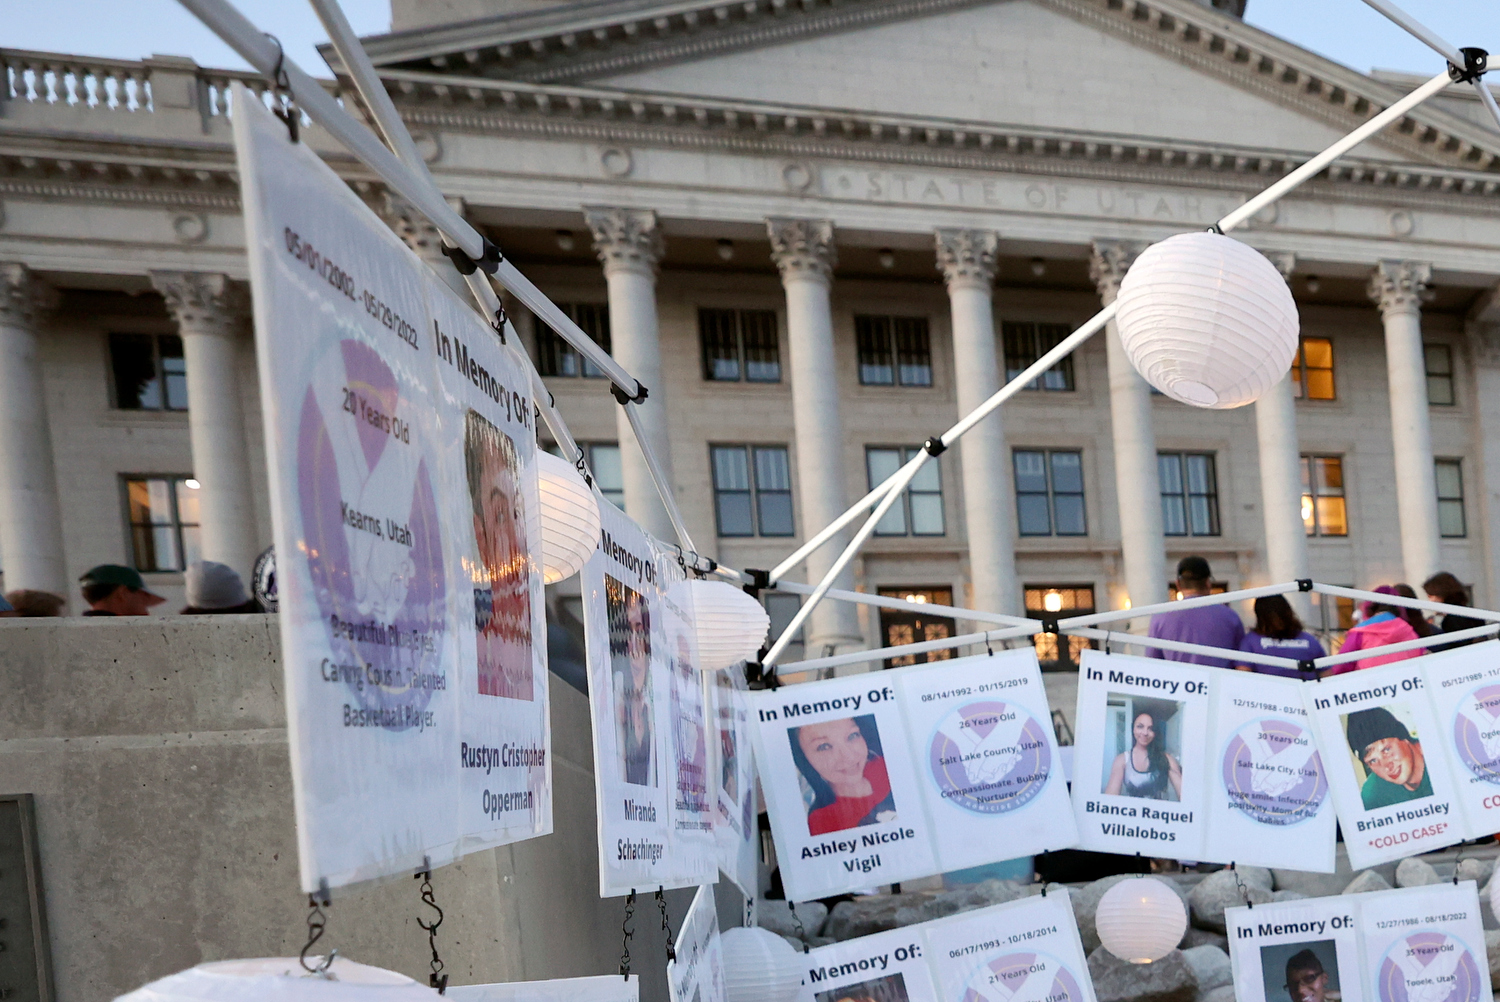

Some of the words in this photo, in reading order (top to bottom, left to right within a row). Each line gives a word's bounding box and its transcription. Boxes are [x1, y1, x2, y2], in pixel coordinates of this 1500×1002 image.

[866, 172, 998, 204] STATE
[1024, 181, 1068, 209] OF
[1097, 188, 1203, 220] UTAH
[434, 319, 452, 365] In
[455, 337, 510, 422] Memory
[342, 502, 384, 540] Kearns,
[386, 519, 412, 547] Utah
[602, 529, 642, 574] Memory
[1087, 668, 1103, 681] In
[1109, 671, 1179, 694] Memory
[759, 709, 777, 722] In
[783, 695, 861, 719] Memory
[1315, 697, 1330, 709] In
[1335, 684, 1397, 704] Memory
[973, 714, 998, 726] Years
[1270, 734, 1291, 743] Years
[461, 743, 499, 775] Rustyn
[502, 743, 545, 772] Cristopher
[939, 756, 956, 766] Salt
[959, 750, 981, 762] Lake
[984, 744, 1019, 759] County,
[1022, 740, 1043, 750] Utah
[1238, 760, 1253, 768] Salt
[1256, 763, 1275, 771] Lake
[483, 789, 532, 820] Opperman
[624, 798, 656, 822] Miranda
[1086, 801, 1137, 817] Bianca
[1142, 808, 1193, 824] Raquel
[1357, 816, 1393, 832] Brian
[1397, 802, 1450, 822] Housley
[801, 838, 857, 859] Ashley
[862, 827, 915, 847] Nicole
[1101, 823, 1176, 841] Villalobos
[618, 839, 663, 865] Schachinger
[844, 855, 881, 875] Vigil
[1008, 926, 1057, 943] 10/18/2014
[1237, 926, 1253, 938] In
[1259, 920, 1325, 937] Memory
[1417, 946, 1439, 956] Years
[810, 954, 888, 983] Memory
[1001, 968, 1027, 981] Years
[1436, 974, 1456, 983] Utah
